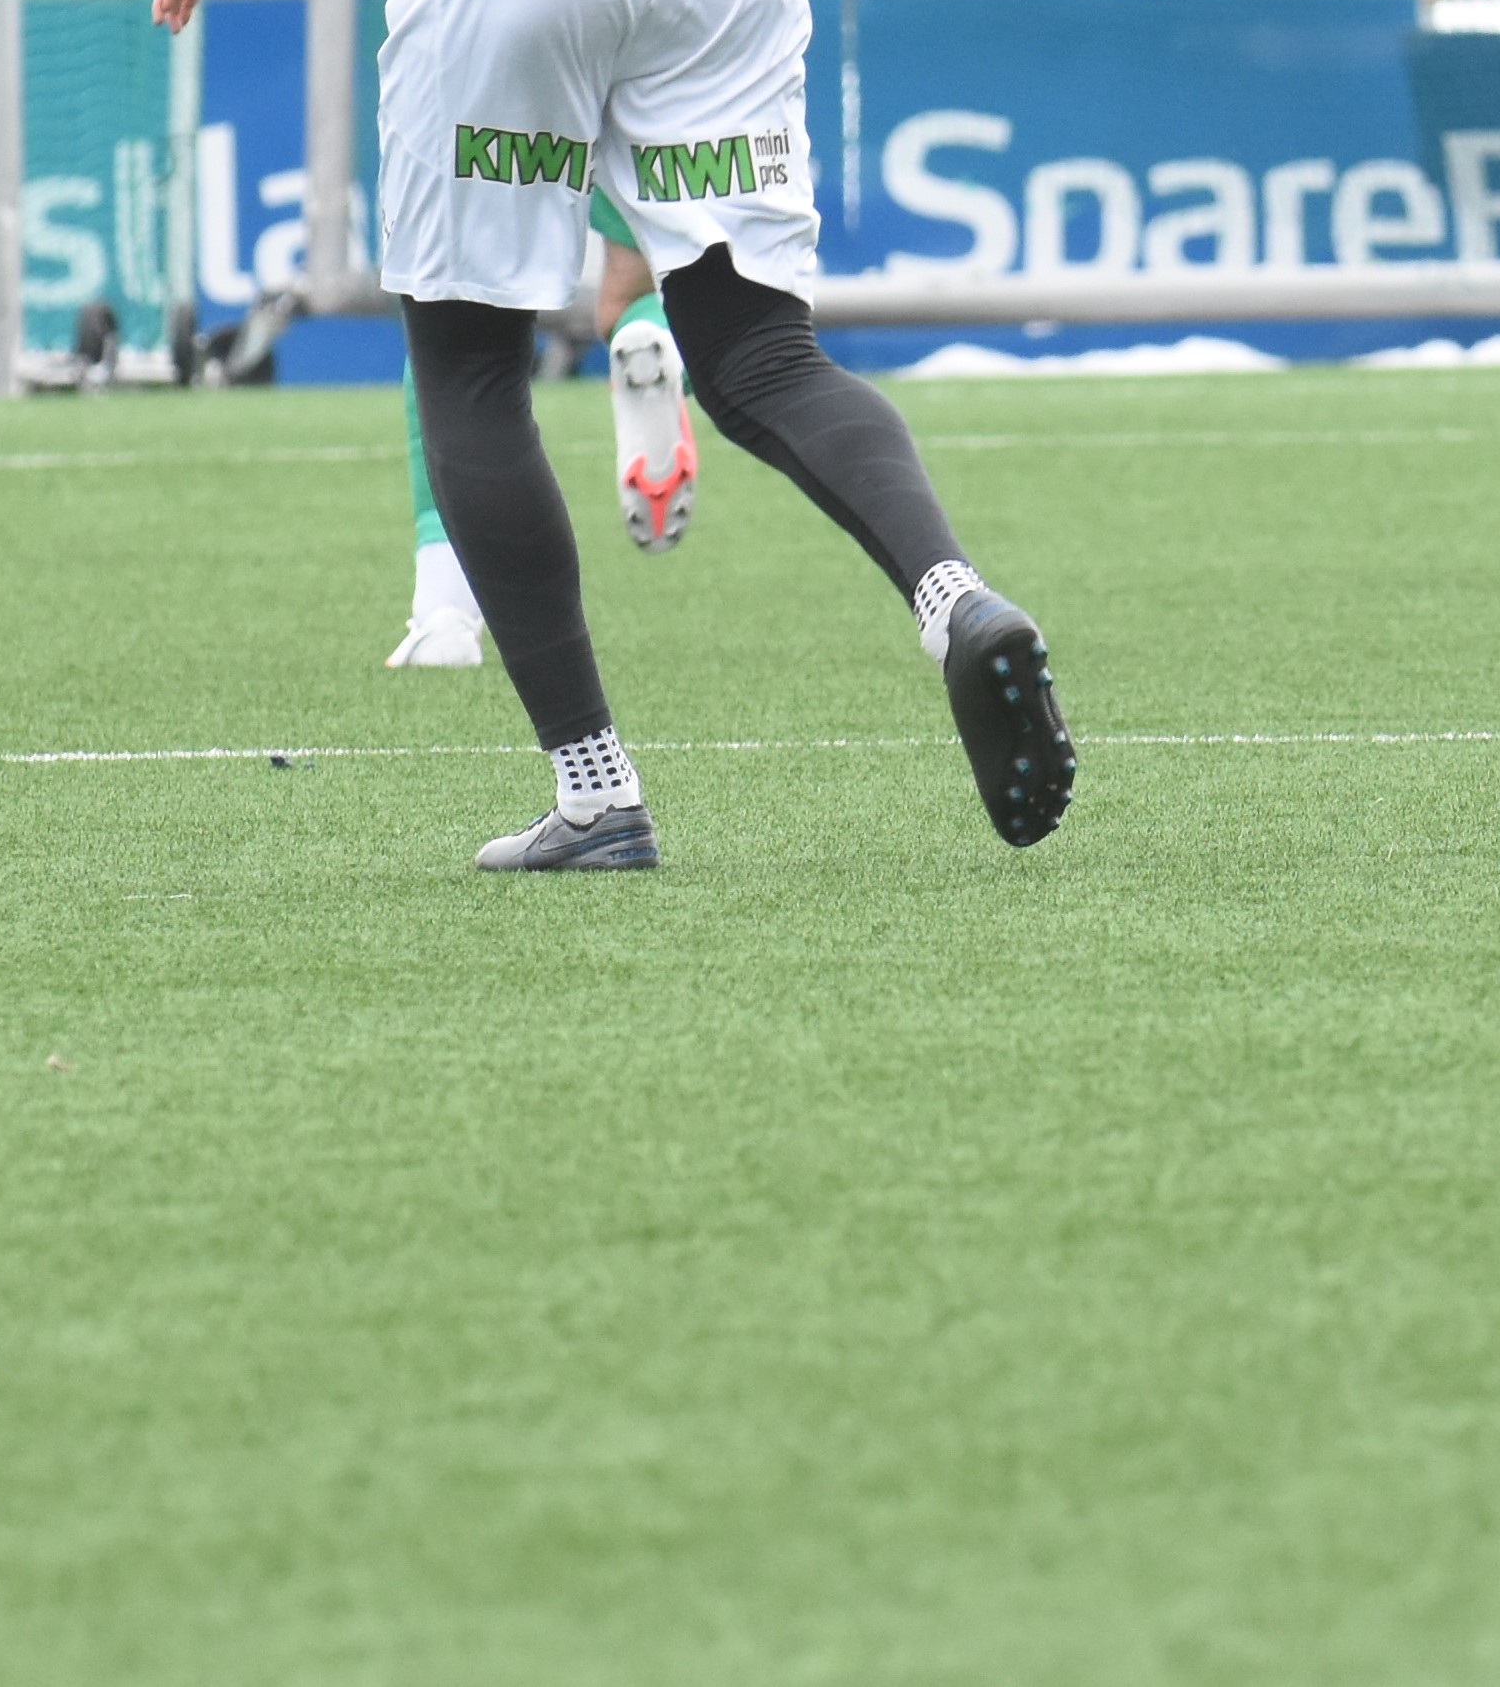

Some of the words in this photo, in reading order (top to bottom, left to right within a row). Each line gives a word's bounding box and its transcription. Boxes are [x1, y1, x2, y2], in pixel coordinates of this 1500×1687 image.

[453, 123, 590, 194] KIWI
[753, 127, 791, 157] mini
[629, 134, 759, 204] KIWI
[758, 157, 789, 193] pris
